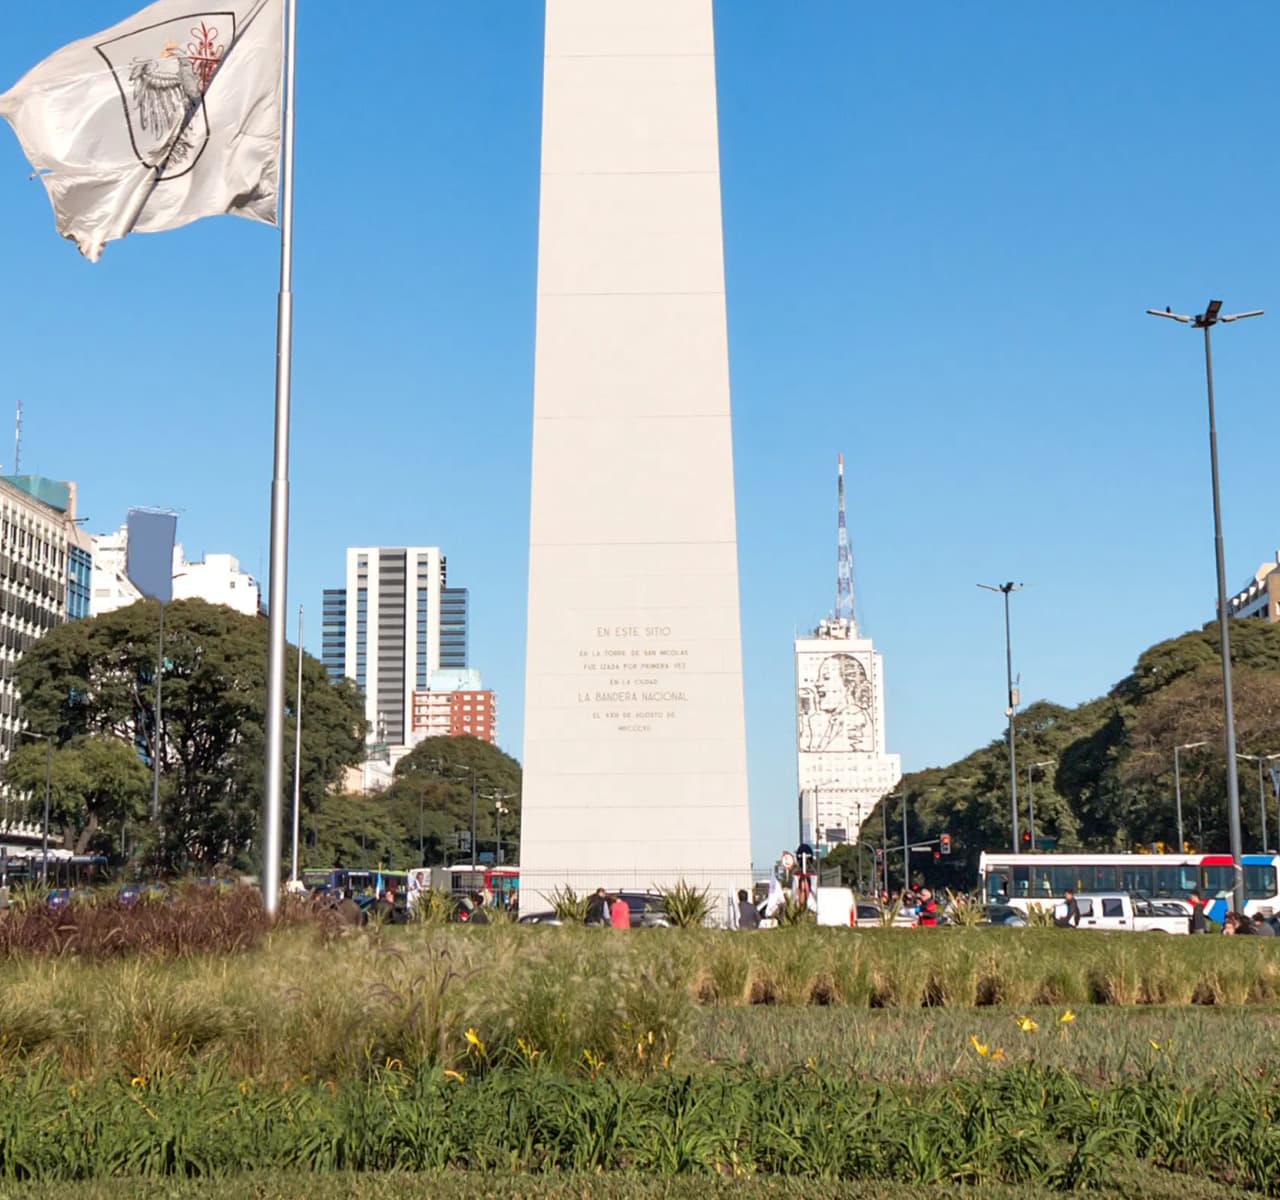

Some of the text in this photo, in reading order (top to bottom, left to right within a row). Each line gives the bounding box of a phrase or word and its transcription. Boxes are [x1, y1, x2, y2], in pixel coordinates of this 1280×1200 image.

[597, 626, 671, 637] EN ESTE SITIO
[578, 691, 688, 703] LA BANDERA NACIONAL
